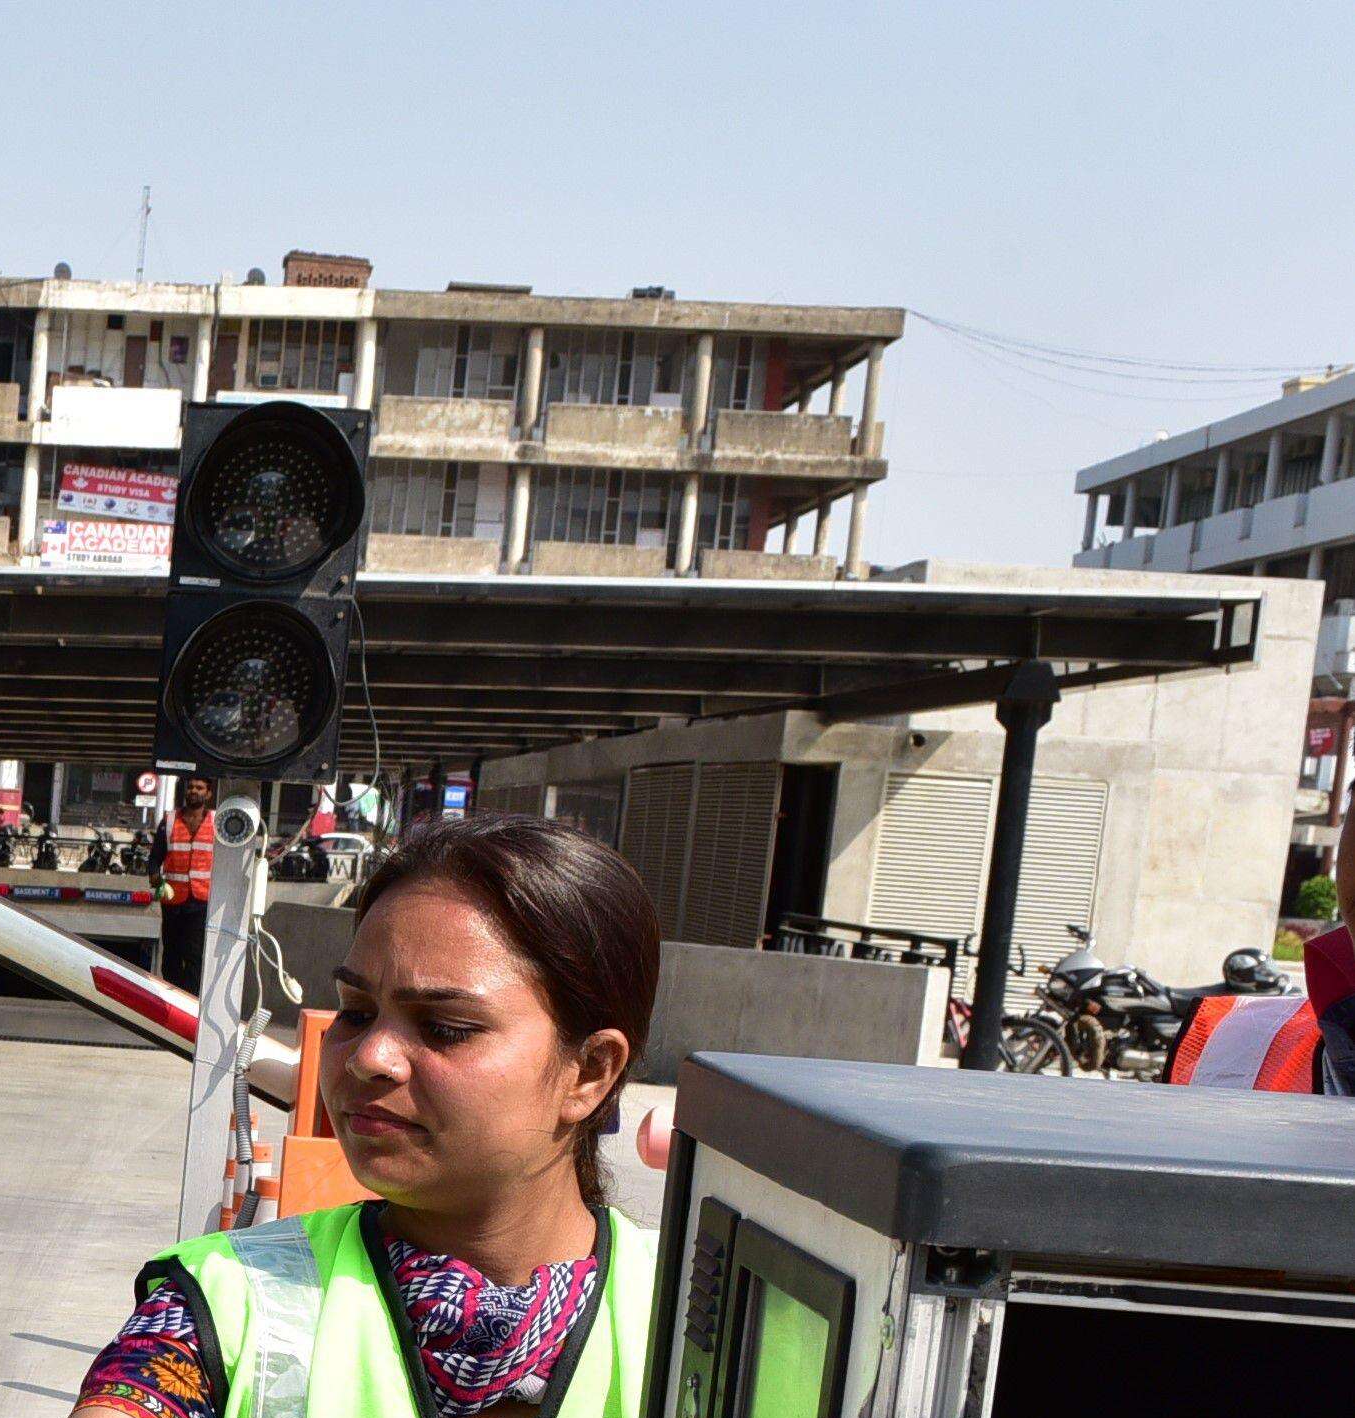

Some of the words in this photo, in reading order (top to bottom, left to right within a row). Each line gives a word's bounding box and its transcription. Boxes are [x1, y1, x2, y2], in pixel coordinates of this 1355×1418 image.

[63, 463, 127, 482] CANADIAN
[96, 483, 127, 494] STUDY
[129, 487, 150, 498] VISA
[70, 520, 170, 540] CANADIAN
[70, 537, 168, 555] ACADEMY
[67, 552, 90, 562] STUDY
[14, 887, 50, 897] BASEMENT
[85, 890, 121, 900] BASEMENT
